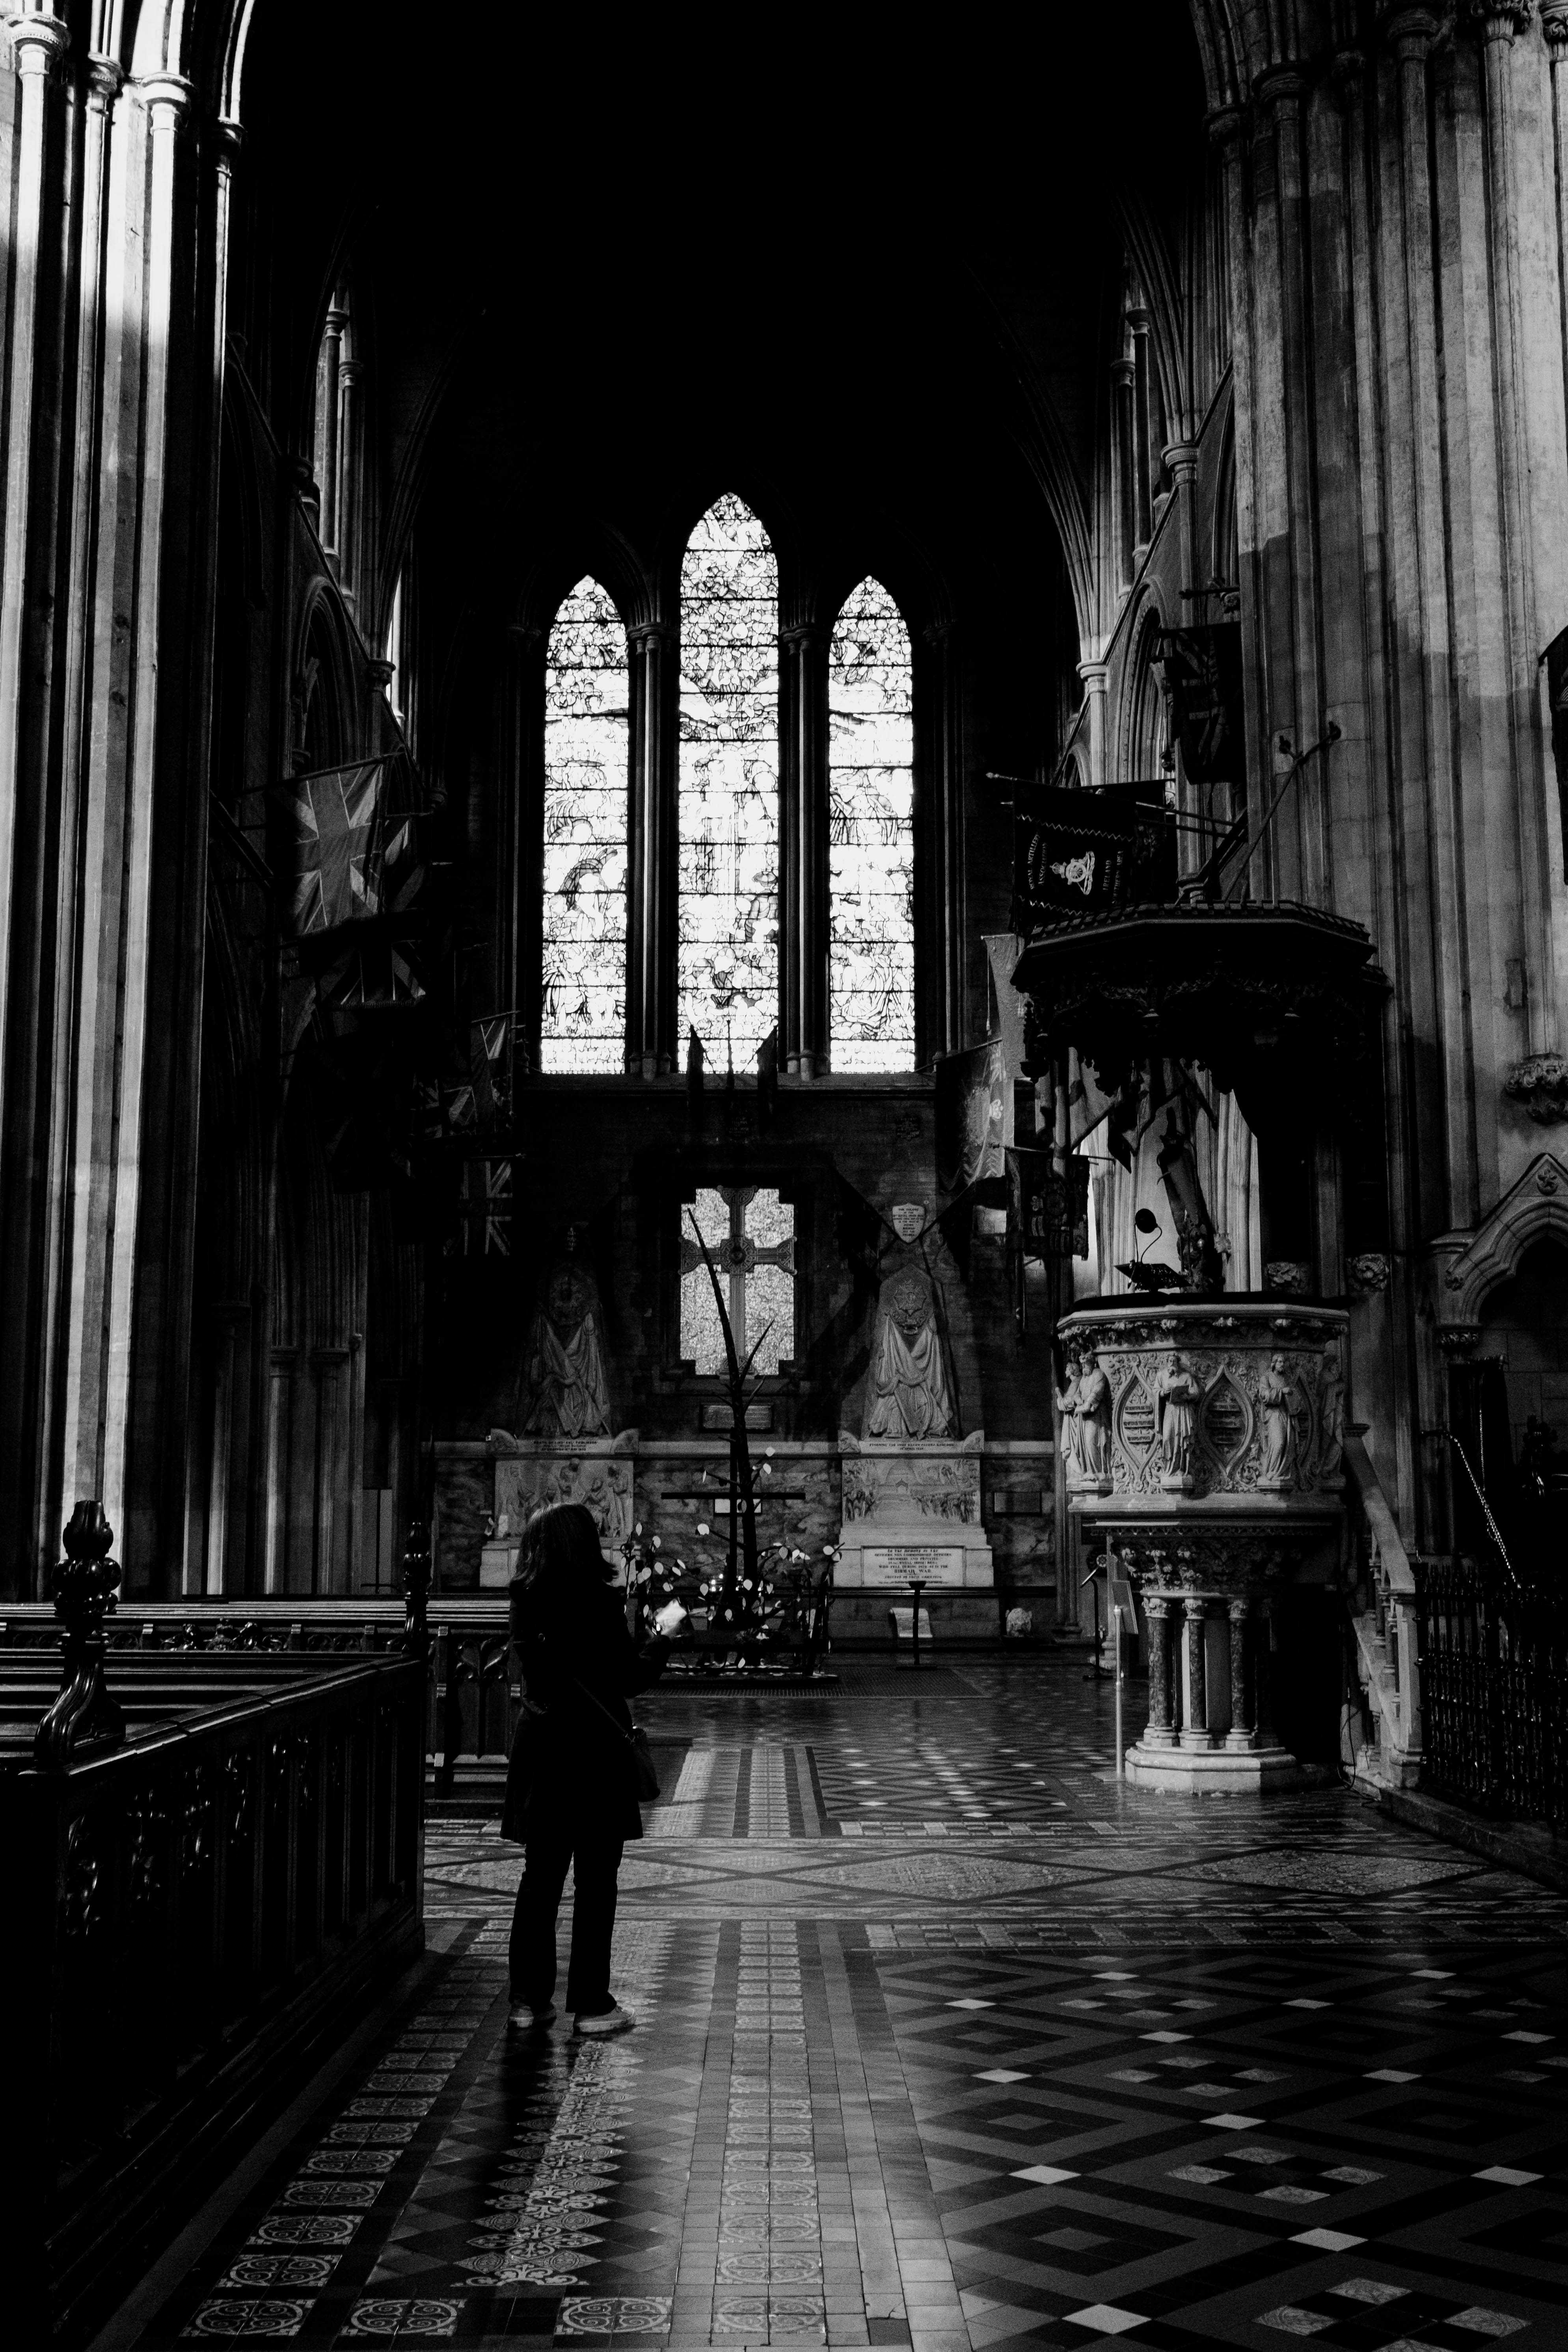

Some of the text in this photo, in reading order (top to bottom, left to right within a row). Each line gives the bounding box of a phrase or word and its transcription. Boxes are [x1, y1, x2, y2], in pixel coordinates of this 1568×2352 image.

[1027, 833, 1041, 890] ROYAL ARTILLERY
[1102, 860, 1112, 890] IRELAND
